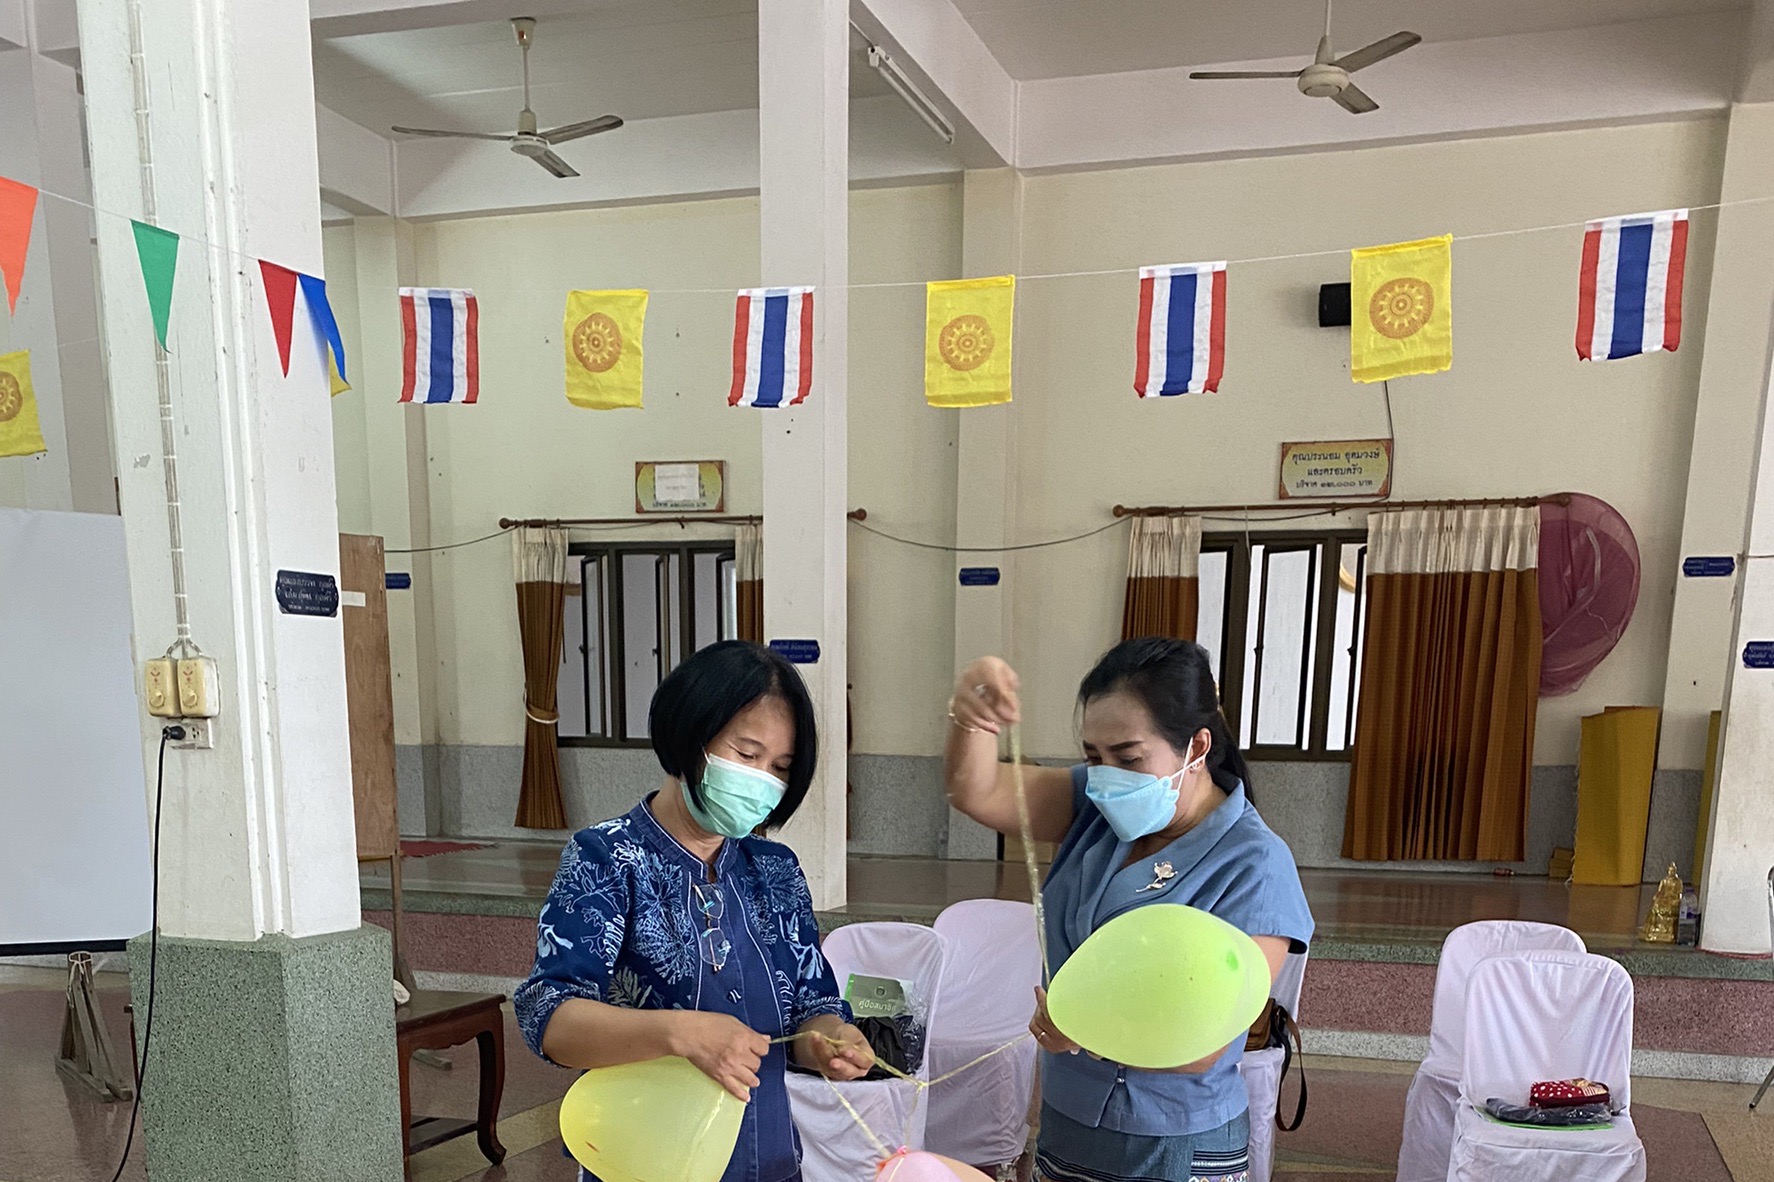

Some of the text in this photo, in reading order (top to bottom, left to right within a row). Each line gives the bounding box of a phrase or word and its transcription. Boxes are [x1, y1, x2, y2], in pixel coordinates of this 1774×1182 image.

[1307, 463, 1363, 476] และครอบครัว
